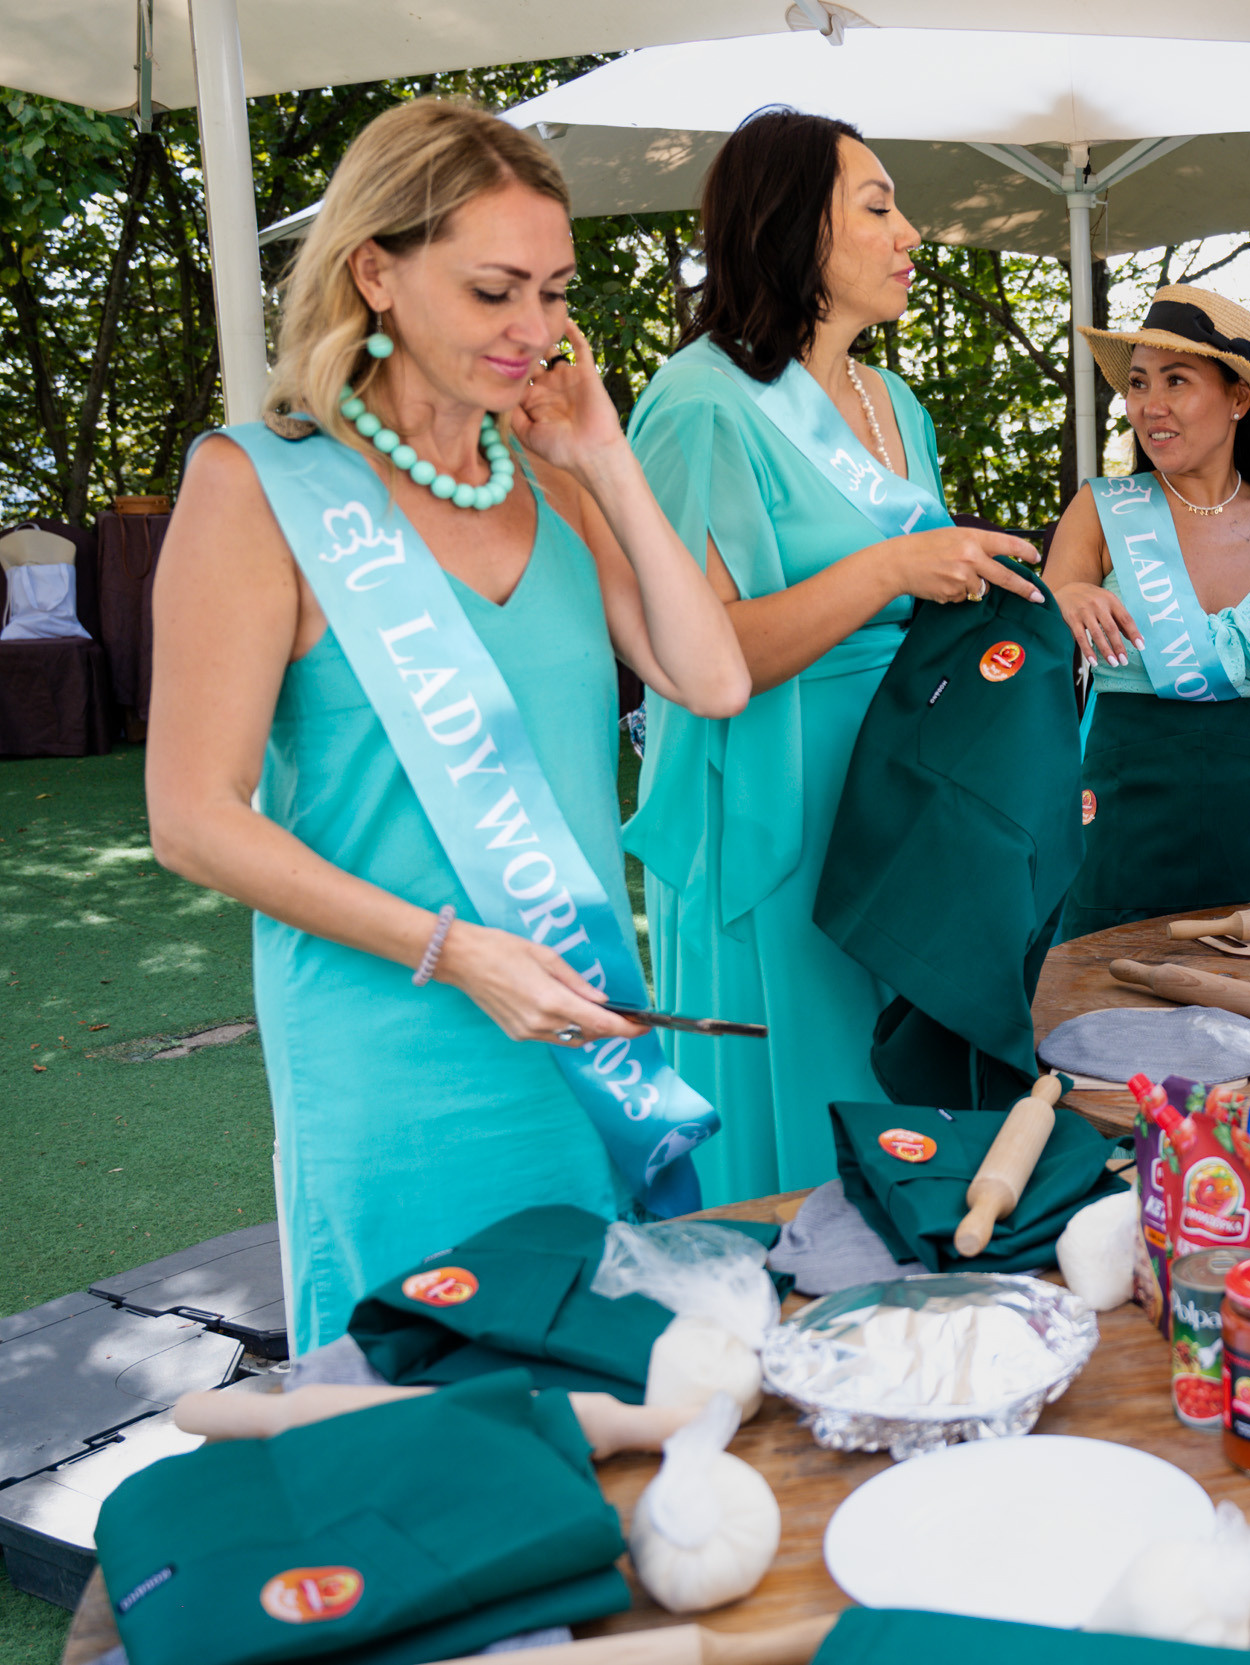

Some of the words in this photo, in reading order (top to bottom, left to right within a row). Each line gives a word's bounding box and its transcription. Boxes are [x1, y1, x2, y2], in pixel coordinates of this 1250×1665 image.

[1123, 529, 1184, 627] LADY
[378, 610, 508, 788] LADY
[582, 1036, 660, 1121] 023
